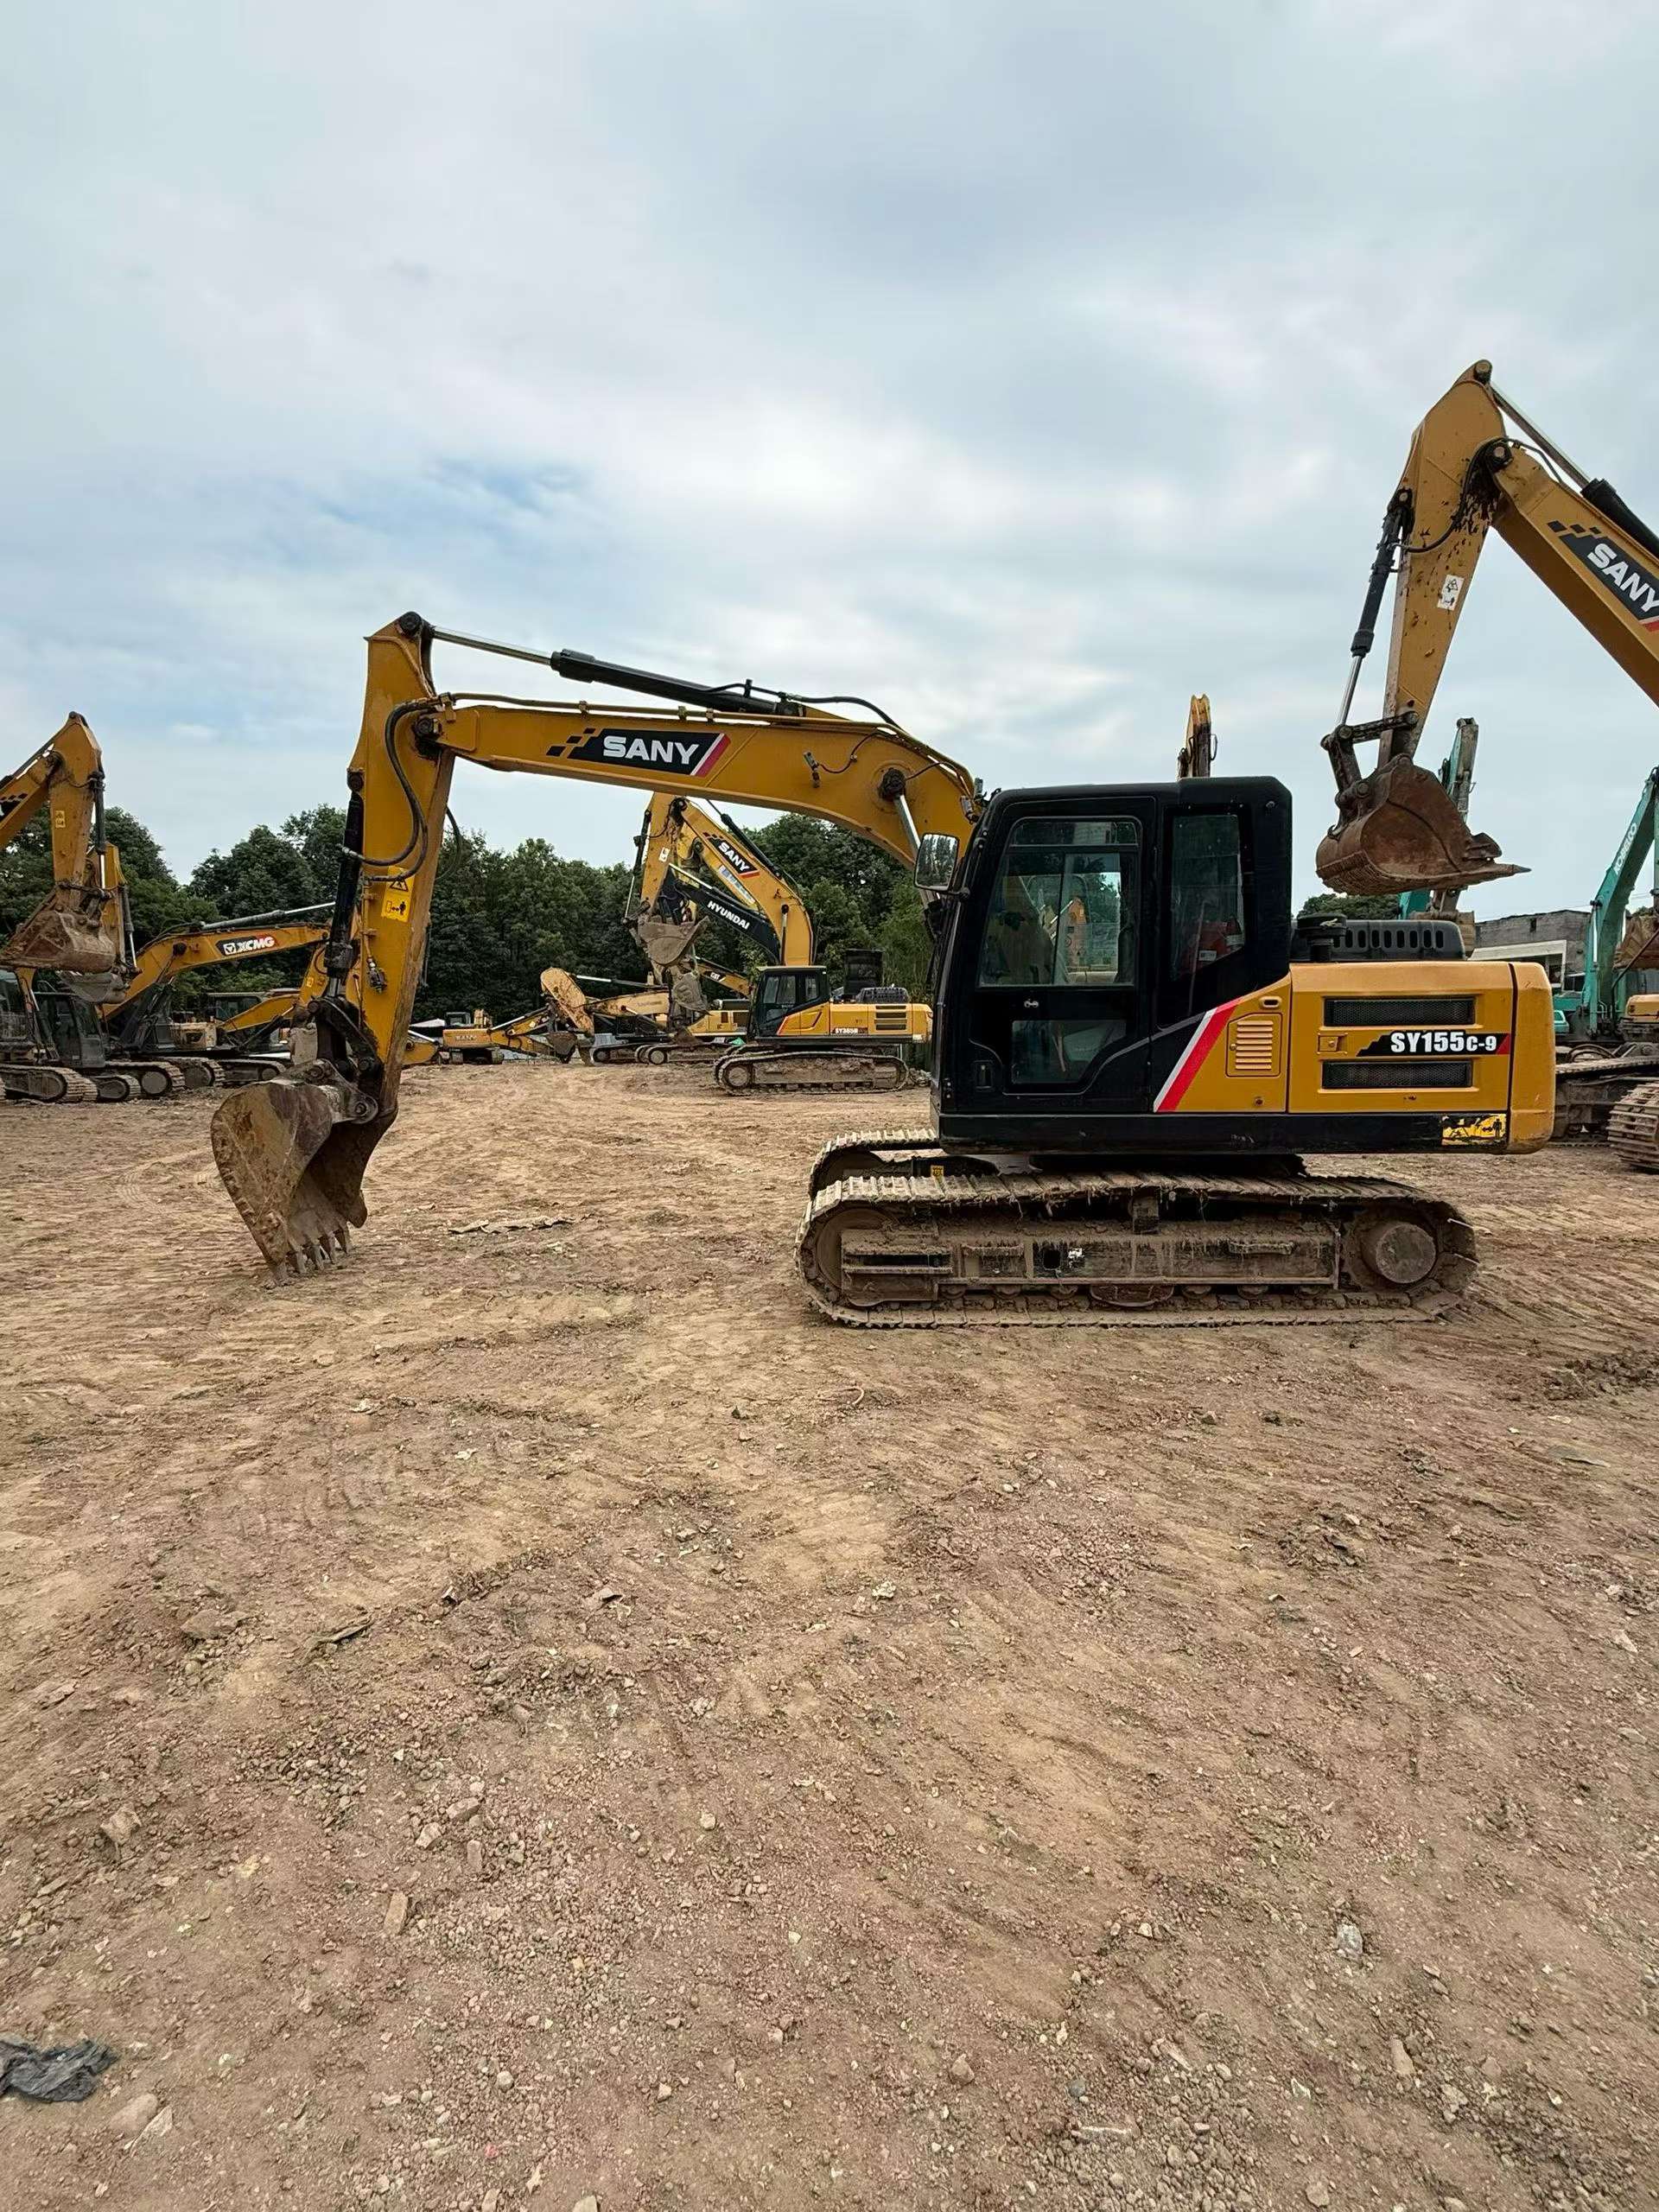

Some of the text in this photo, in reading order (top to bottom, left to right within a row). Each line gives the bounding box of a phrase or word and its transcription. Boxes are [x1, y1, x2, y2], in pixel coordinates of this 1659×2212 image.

[1587, 543, 1659, 613] SANY
[603, 735, 699, 765] SANY
[718, 842, 750, 872] SANY
[707, 900, 750, 930] HYUNDAI
[237, 936, 276, 952] XCMG
